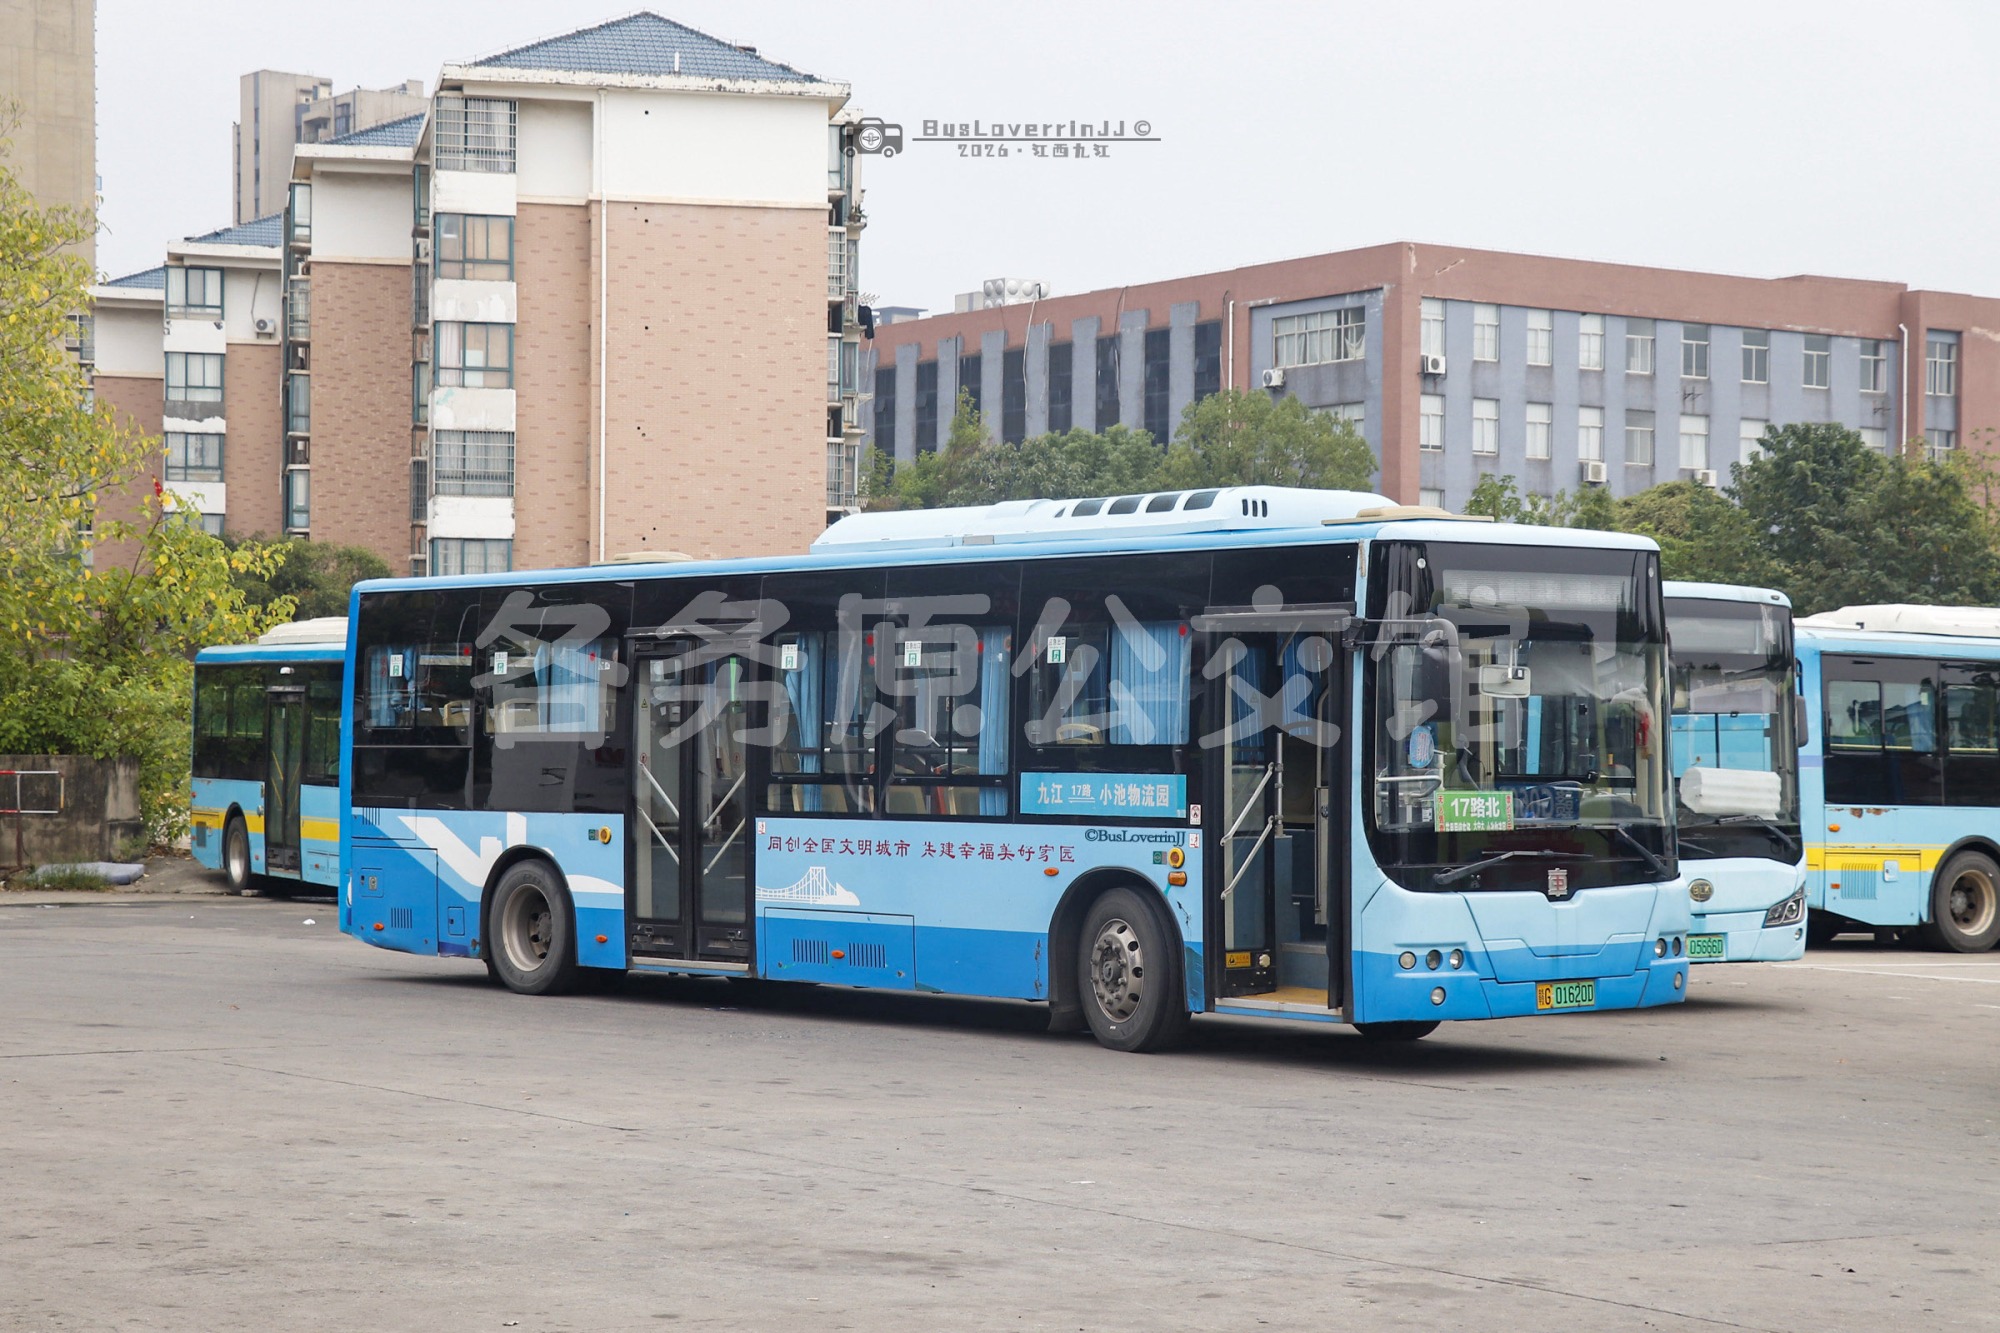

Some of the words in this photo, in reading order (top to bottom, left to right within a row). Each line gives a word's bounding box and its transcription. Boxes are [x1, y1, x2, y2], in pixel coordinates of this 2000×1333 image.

[1037, 782, 1063, 804] 九江
[1071, 784, 1092, 797] 17路
[1100, 783, 1170, 807] 小池物流园
[1450, 796, 1500, 818] 17路北
[767, 836, 911, 858] 同创全国文明城市
[921, 841, 1075, 863] 共建幸福美好家园
